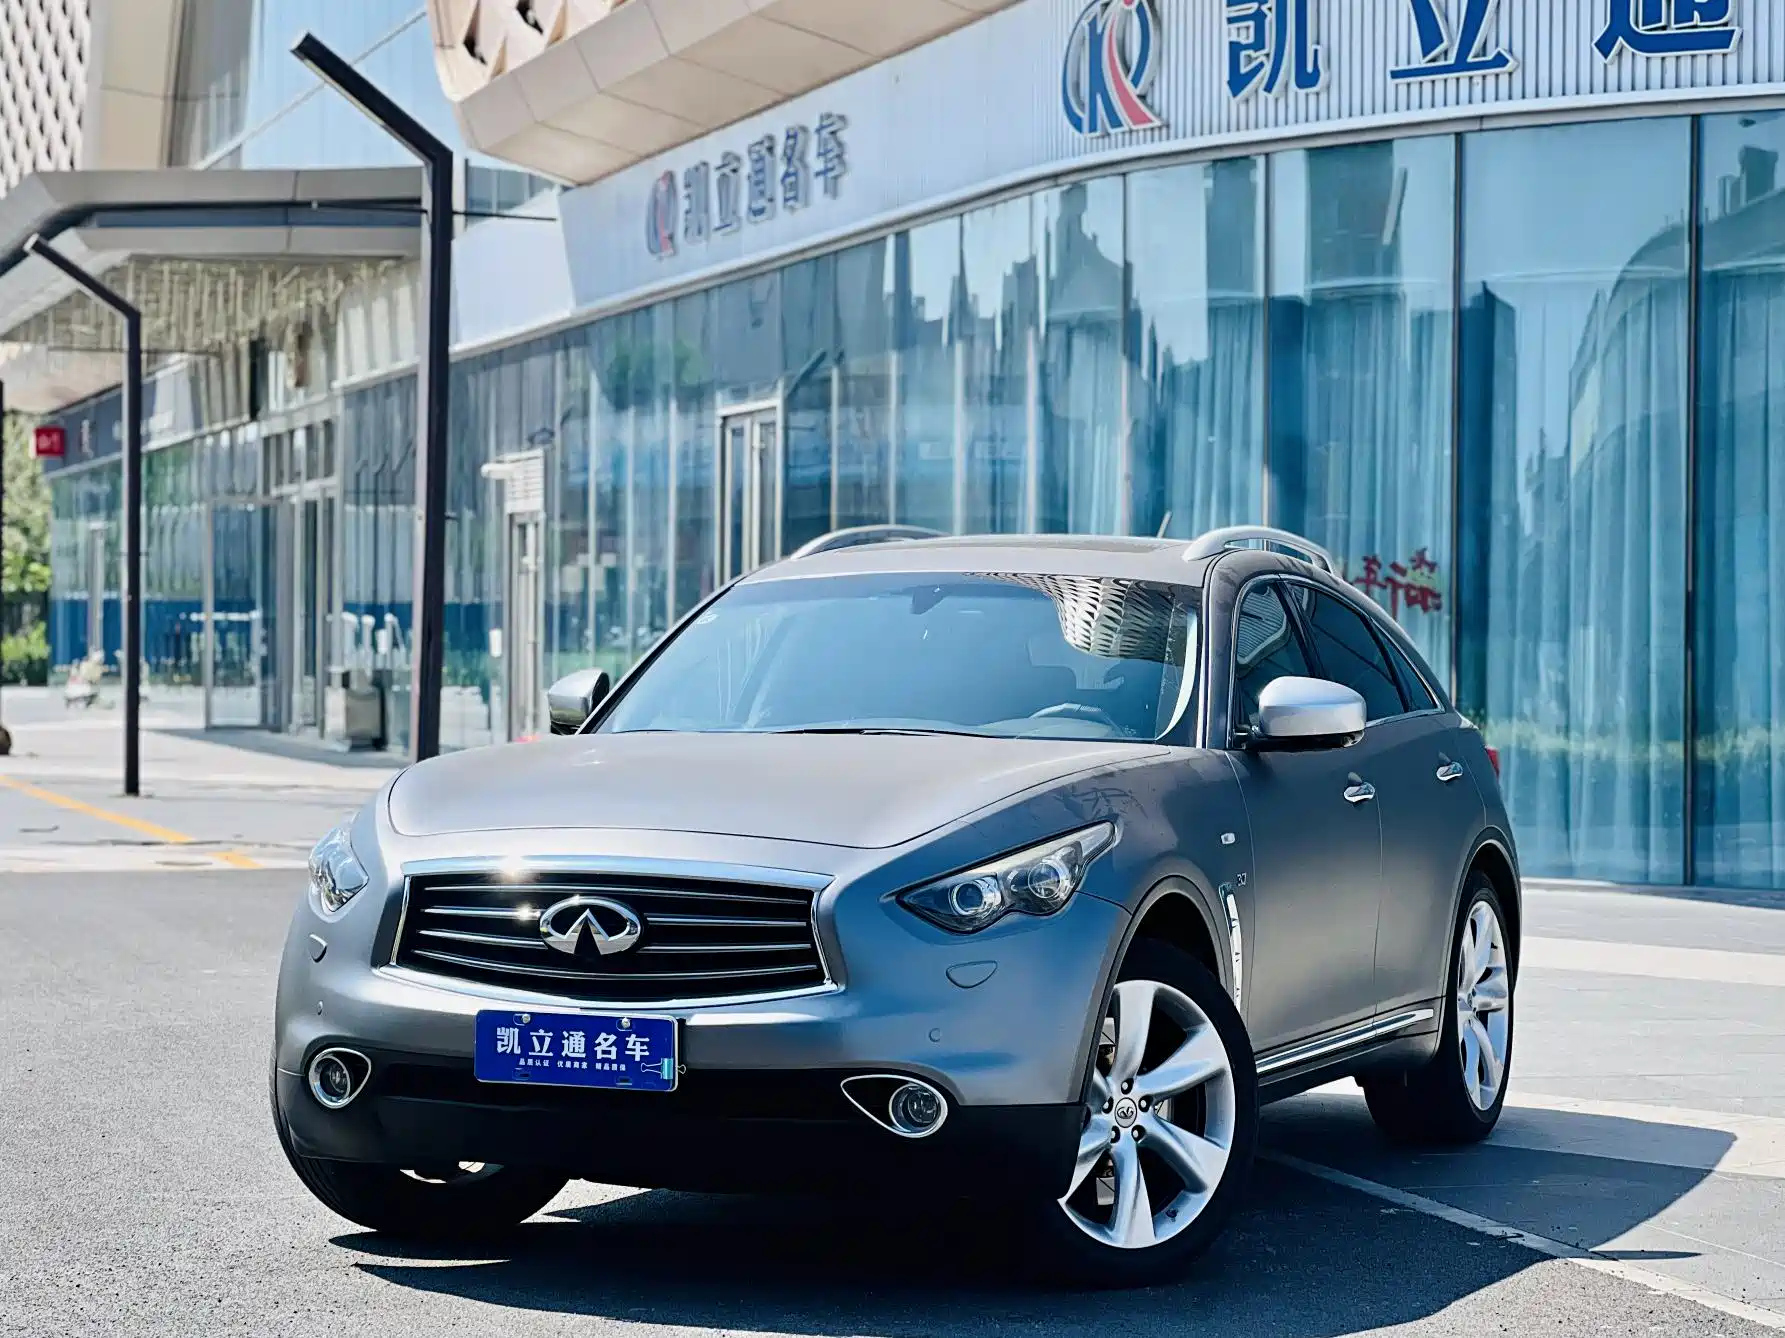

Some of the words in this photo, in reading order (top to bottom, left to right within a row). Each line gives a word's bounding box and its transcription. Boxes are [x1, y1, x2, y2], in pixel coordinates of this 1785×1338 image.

[496, 1026, 650, 1062] 凯立通名车
